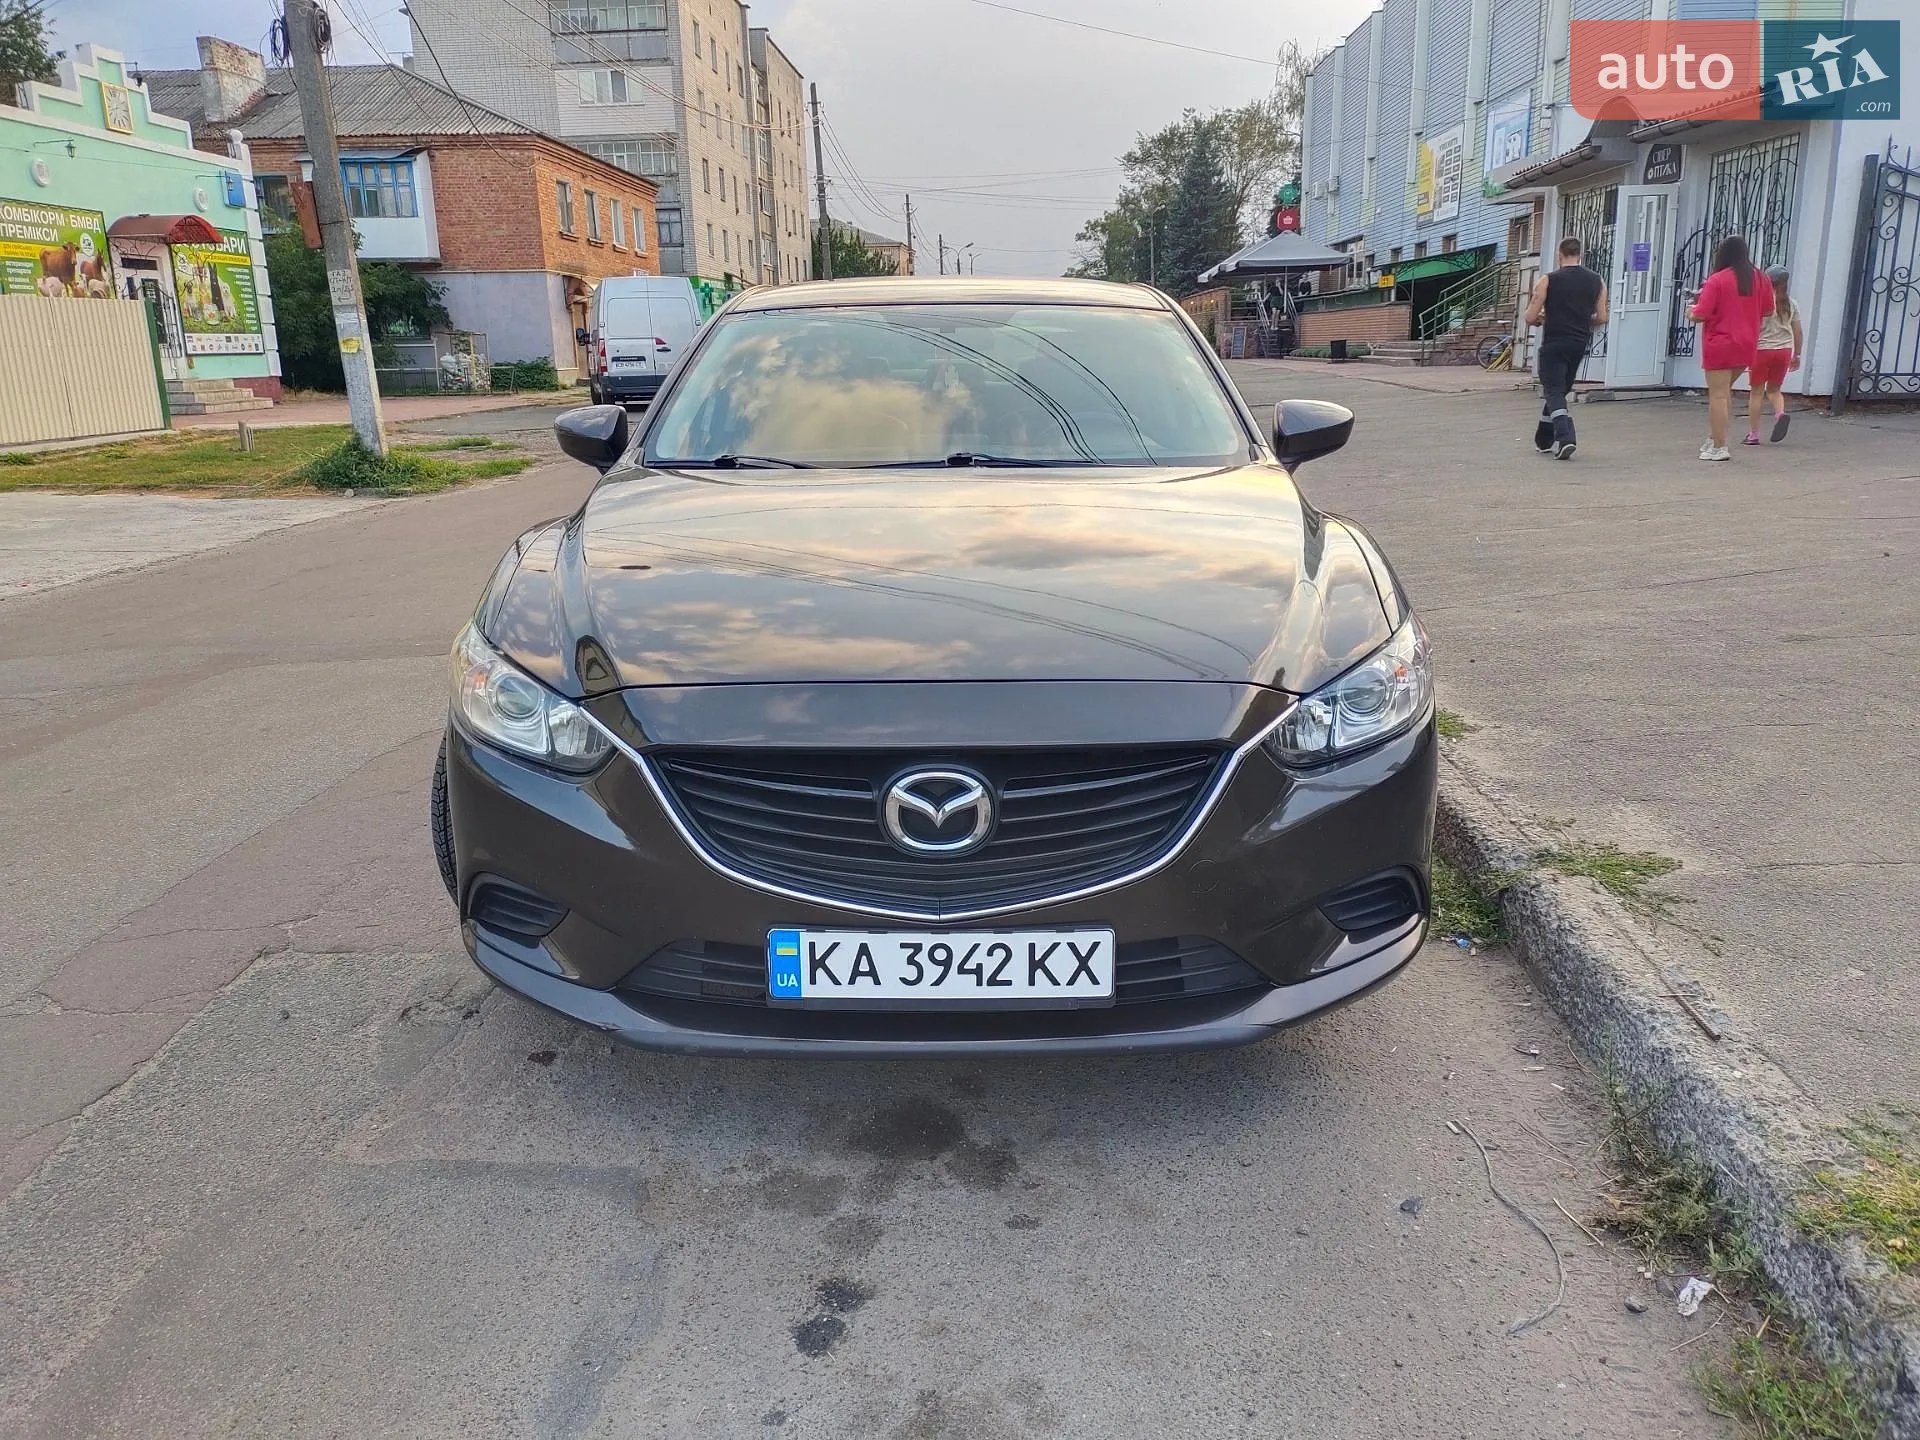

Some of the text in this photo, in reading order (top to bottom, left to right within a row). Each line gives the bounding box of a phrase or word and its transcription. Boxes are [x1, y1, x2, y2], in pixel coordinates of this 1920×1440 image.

[0, 223, 59, 242] ПРЕМІКСИ
[69, 214, 101, 233] БМВД
[808, 941, 1102, 987] KA 3942 KX
[776, 973, 799, 988] UA
